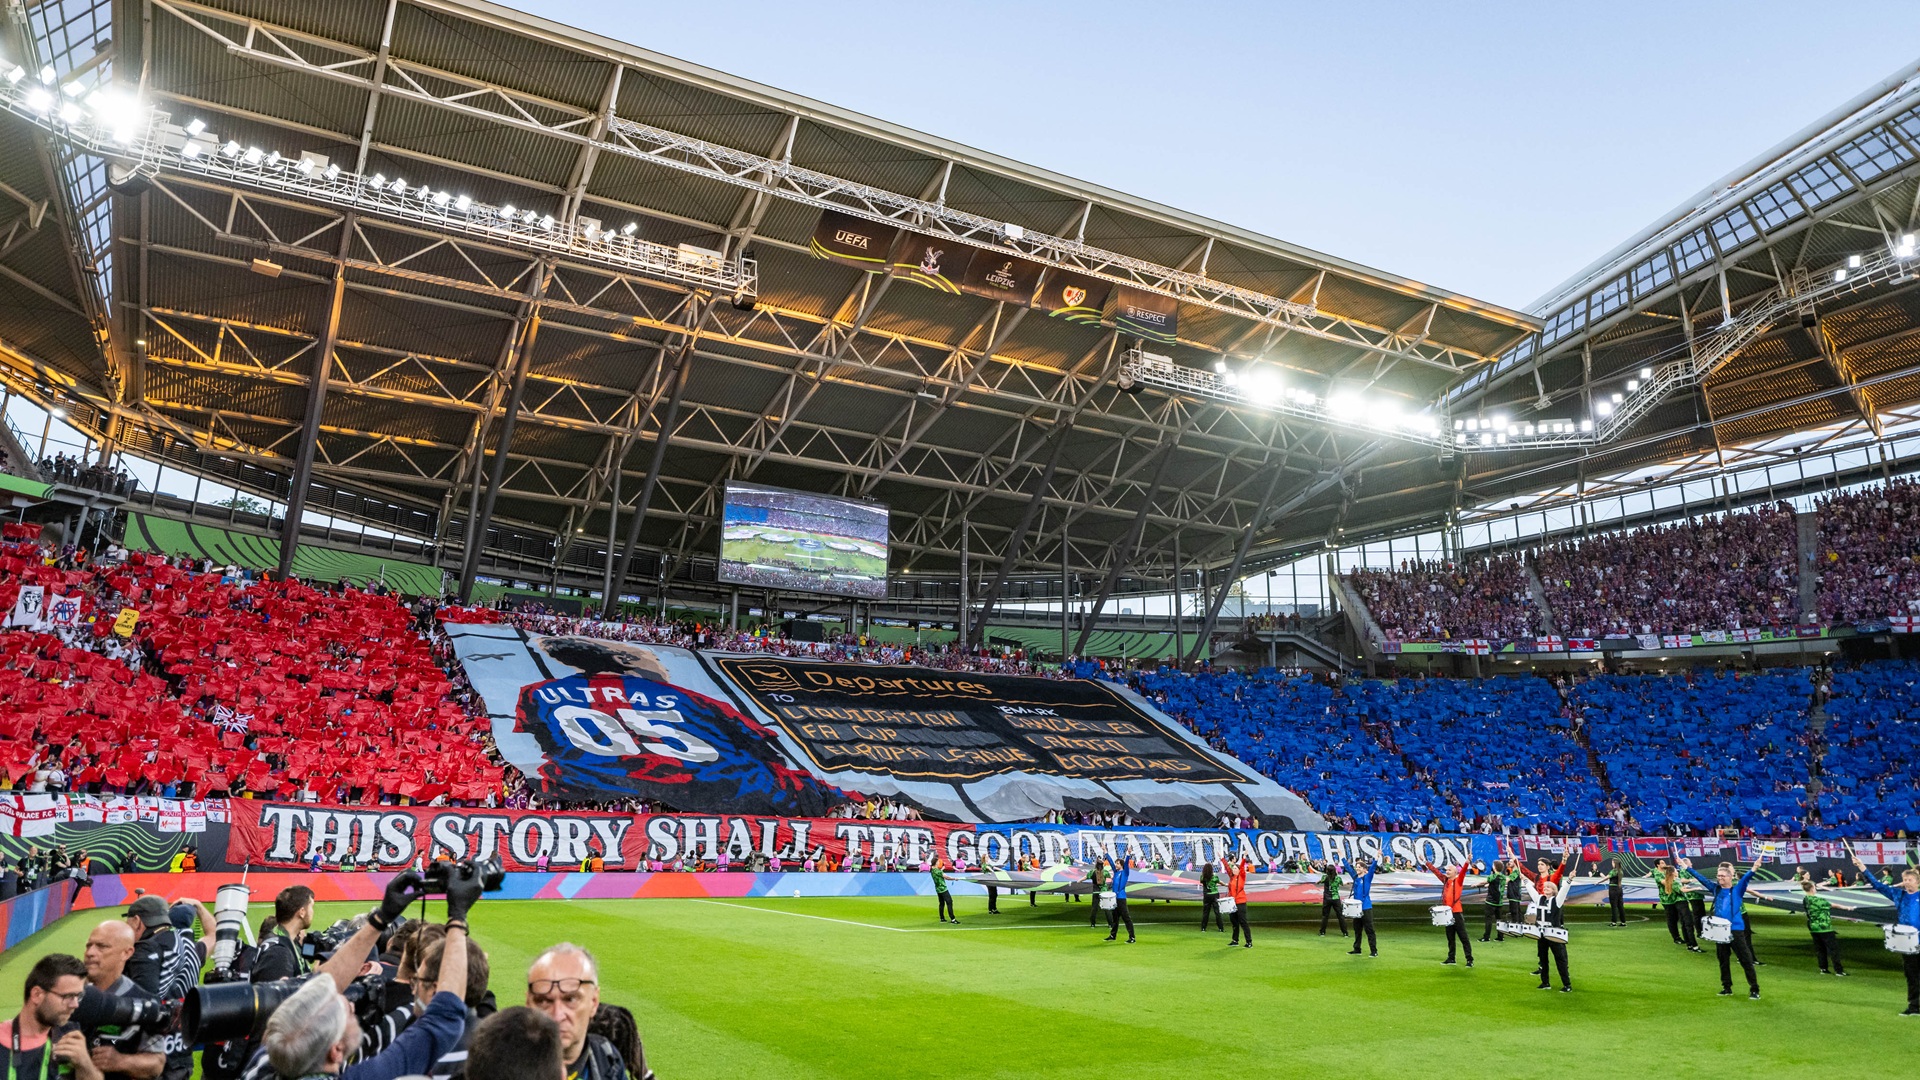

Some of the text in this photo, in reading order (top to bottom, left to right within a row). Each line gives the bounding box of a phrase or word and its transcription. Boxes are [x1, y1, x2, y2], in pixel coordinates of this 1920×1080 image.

[835, 231, 868, 248] UEFA
[985, 273, 1016, 288] LEIPZIG
[1136, 310, 1166, 323] RESPECT
[803, 671, 993, 695] Departures
[537, 686, 679, 709] ULTRAS
[767, 692, 795, 703] TO
[783, 705, 961, 726] LIQUIDATION
[992, 705, 1060, 717] EMARK
[553, 704, 720, 763] 05
[801, 723, 898, 741] FA CUP
[825, 742, 933, 762] EUROPA
[15, 811, 40, 819] PALACE
[262, 805, 416, 865] THIS
[432, 813, 629, 865] STORY
[649, 816, 824, 862] SHALL
[838, 824, 935, 866] THE
[948, 830, 1066, 869] GOOD
[1081, 832, 1174, 867] MAN
[1189, 832, 1306, 868] TEACH
[1317, 834, 1382, 868] HIS
